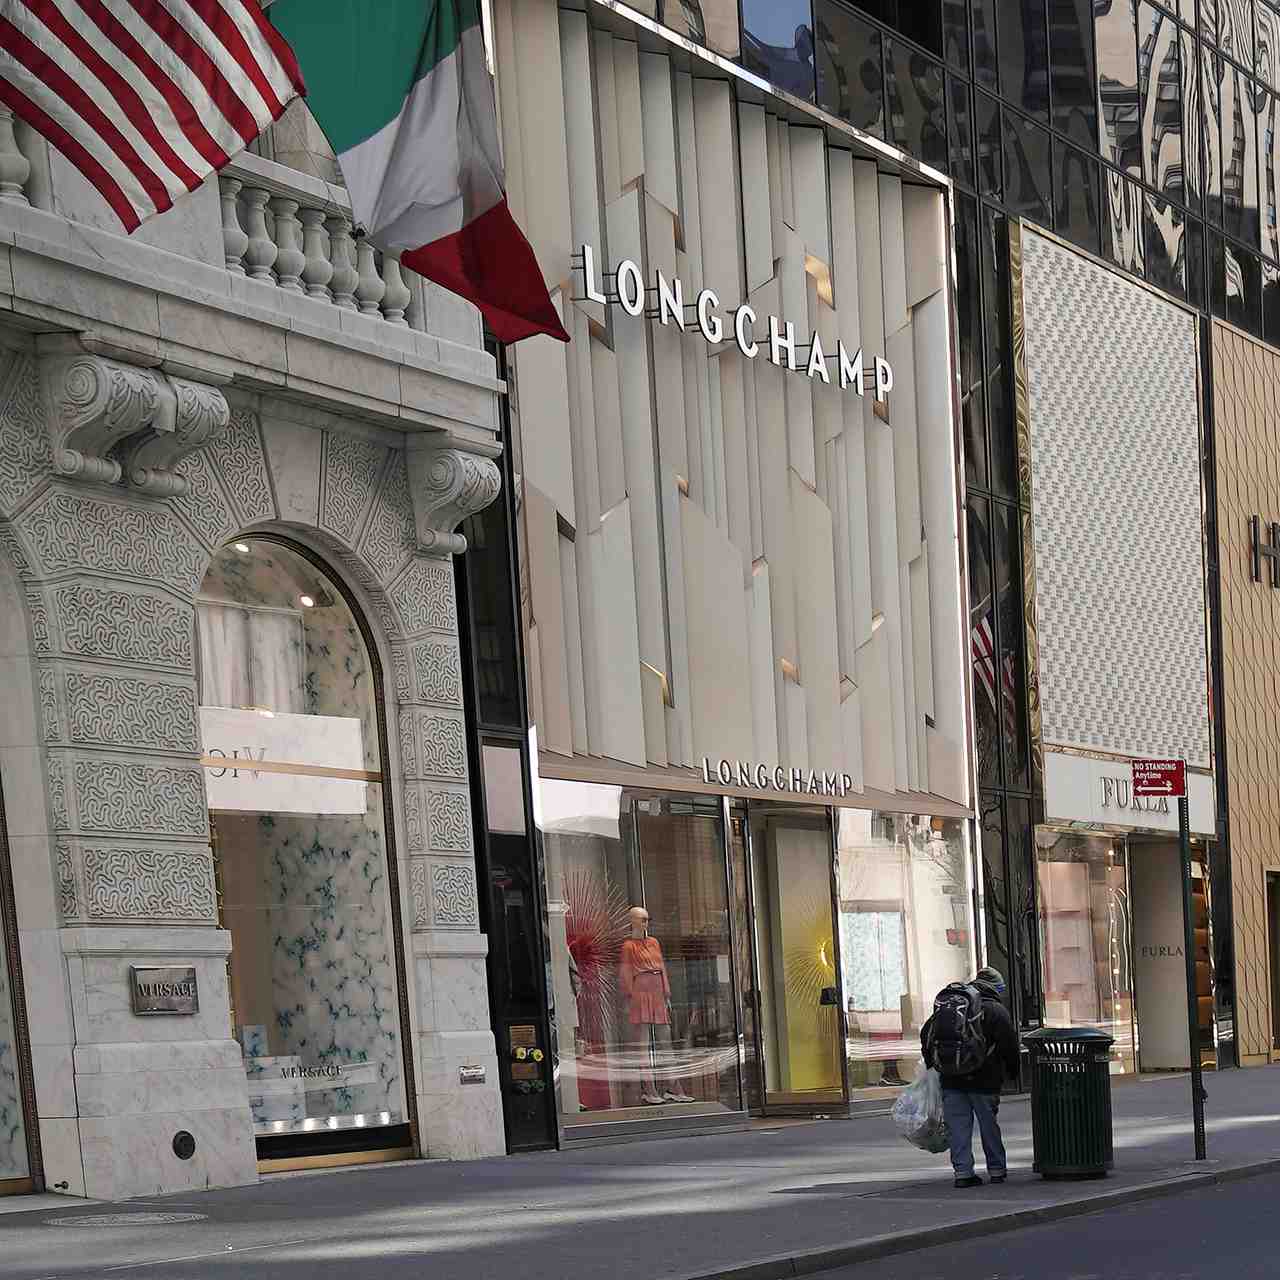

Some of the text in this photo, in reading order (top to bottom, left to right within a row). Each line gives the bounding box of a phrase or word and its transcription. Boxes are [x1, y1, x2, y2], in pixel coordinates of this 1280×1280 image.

[582, 244, 894, 402] LONGCHAMP
[1145, 763, 1177, 771] STANDING
[702, 757, 852, 798] LONGCHAMP
[1134, 772, 1162, 781] Anytime
[138, 983, 196, 998] VERSACE
[280, 1064, 344, 1080] VERSACE
